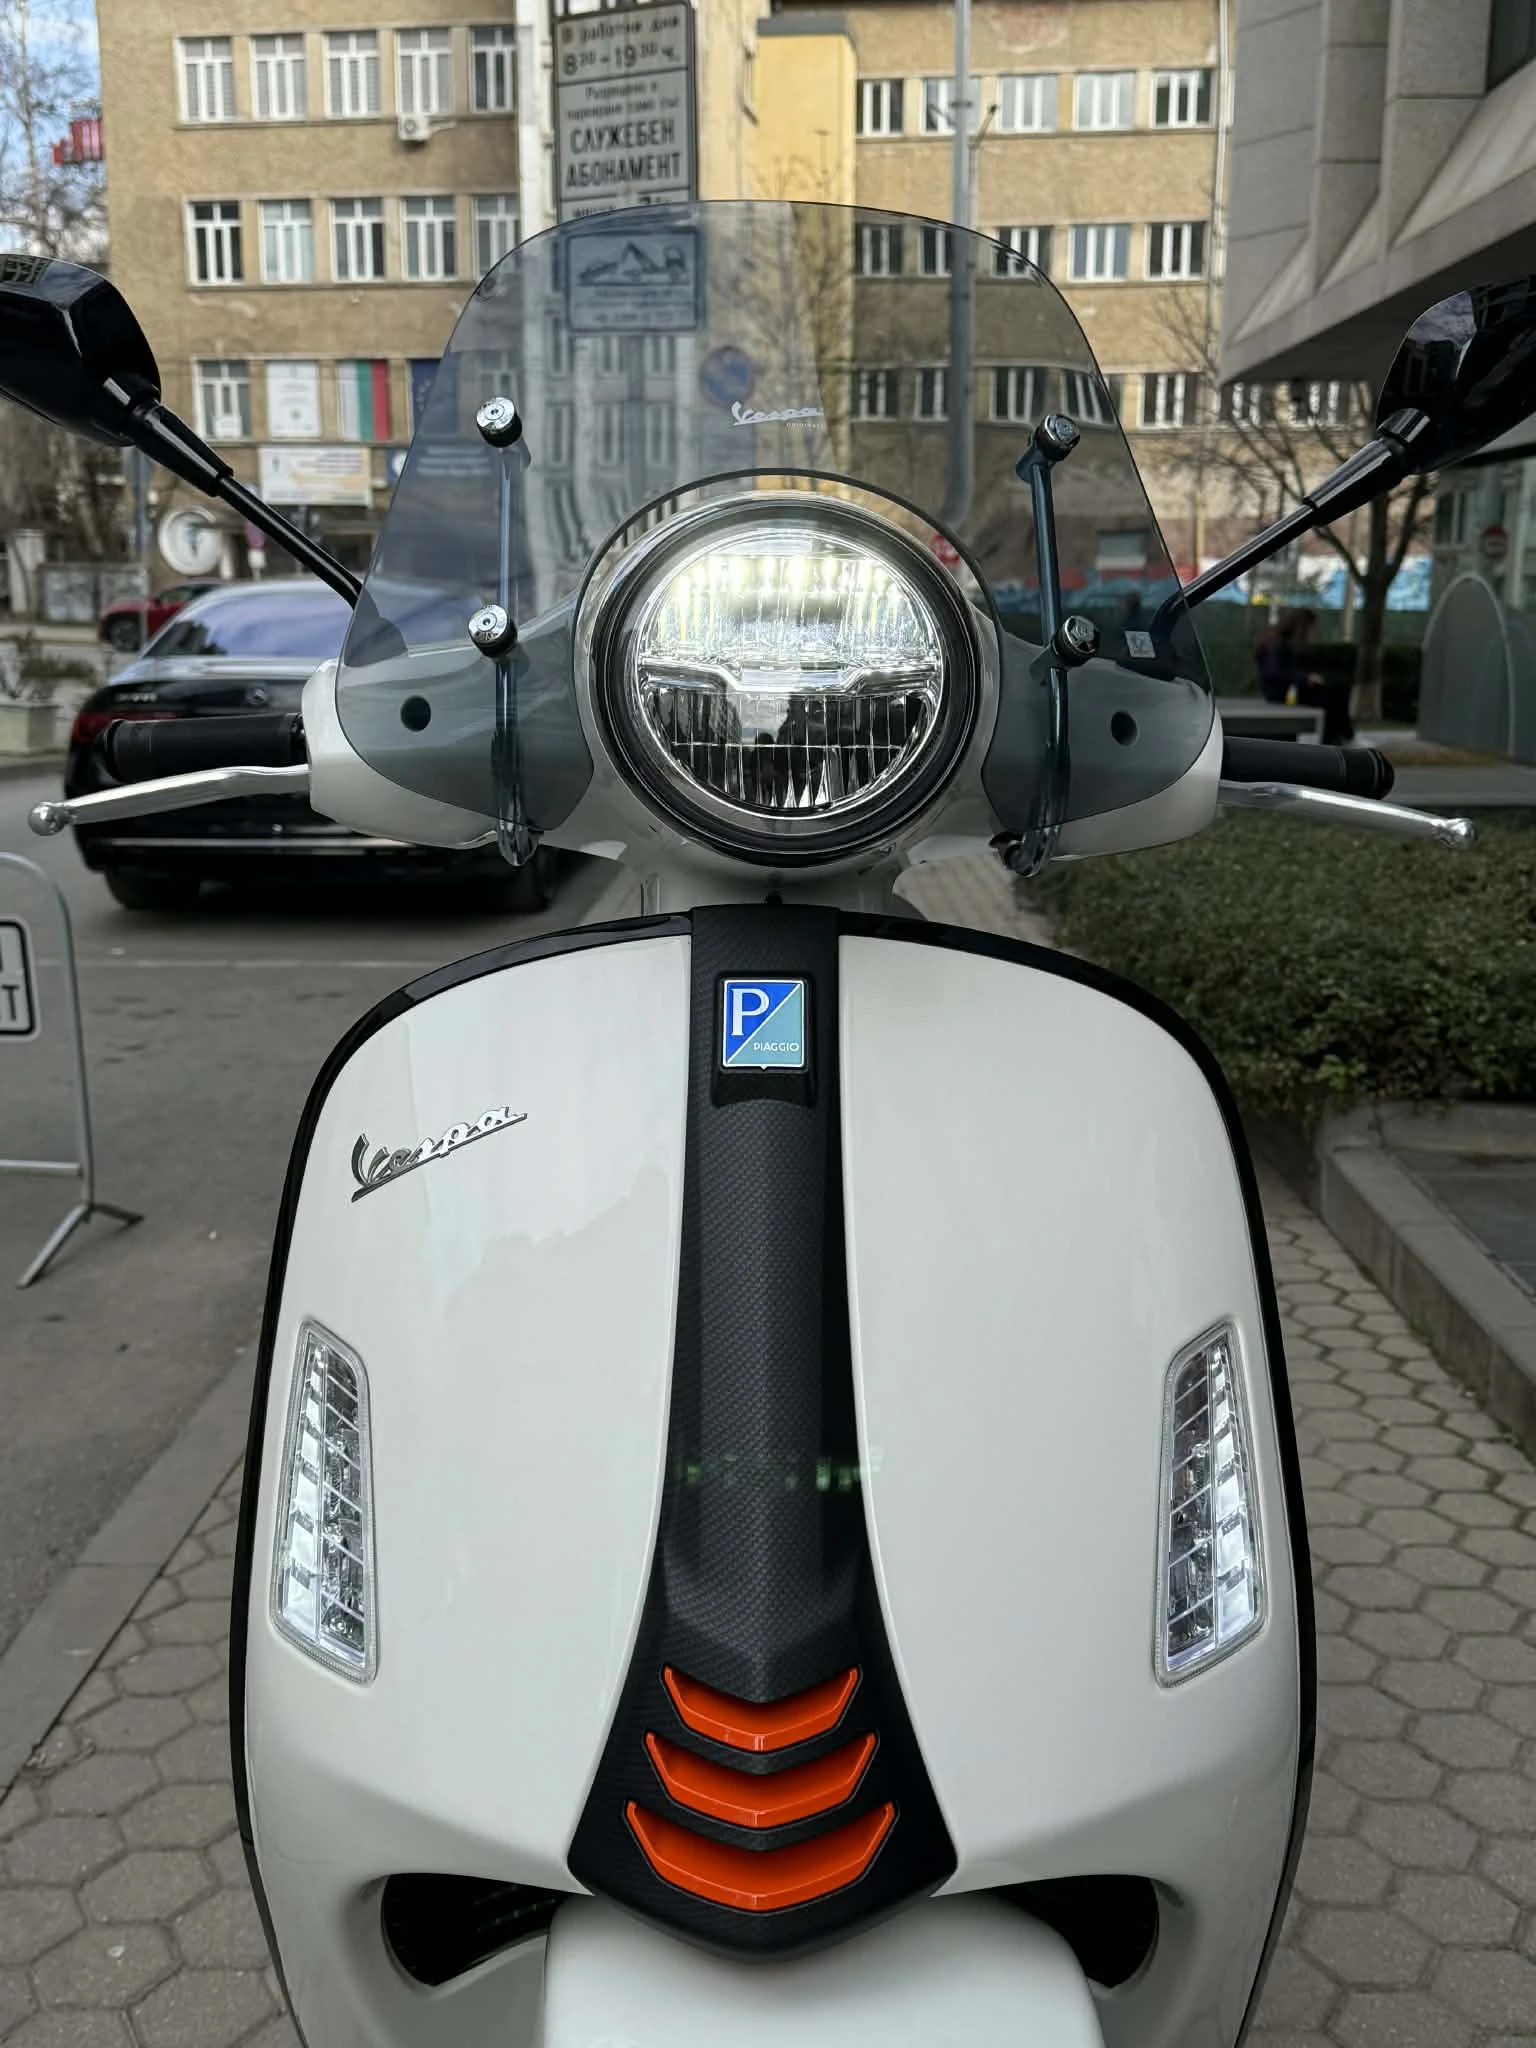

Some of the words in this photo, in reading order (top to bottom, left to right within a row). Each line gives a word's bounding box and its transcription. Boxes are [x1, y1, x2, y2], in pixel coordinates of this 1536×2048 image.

[569, 118, 674, 155] СЛУЖЕБЕН
[565, 151, 681, 187] АБОНАМЕНТ
[730, 400, 825, 426] Vespa
[730, 988, 770, 1036] P
[753, 1042, 800, 1052] PIAGGIO
[351, 1106, 528, 1203] Vespa
